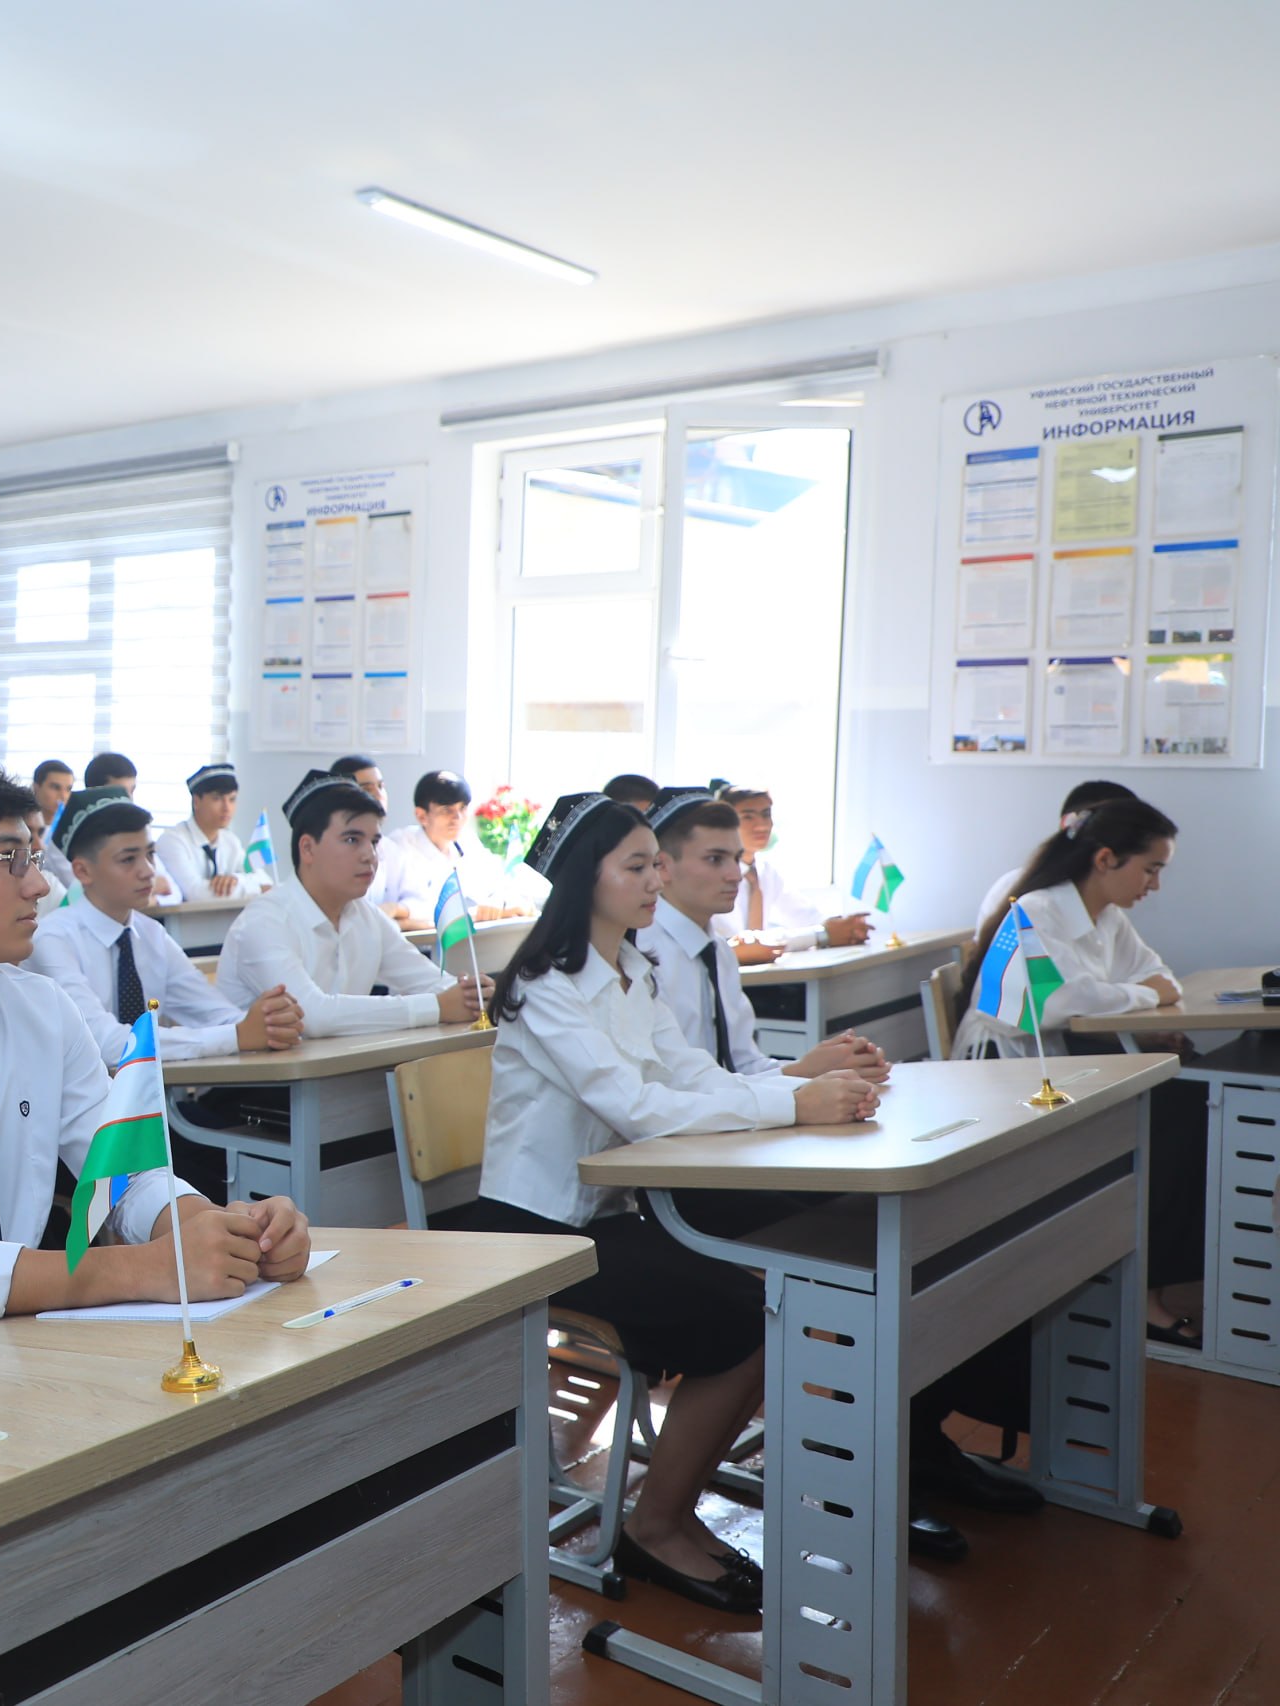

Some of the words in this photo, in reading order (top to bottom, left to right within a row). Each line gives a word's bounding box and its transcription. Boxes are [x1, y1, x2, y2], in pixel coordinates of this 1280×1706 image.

[1030, 383, 1094, 398] УФИМСКИЙ
[1097, 367, 1214, 391] ГОСУДАРСТВЕННЫЙ
[1111, 383, 1196, 401] ТЕХНИЧЕСКИЙ
[1079, 400, 1159, 416] УНИВЕРСИТЕТ
[1042, 410, 1196, 440] ИНФОРМАЦИЯ
[306, 500, 387, 516] ИНФОРМАЦИЯ
